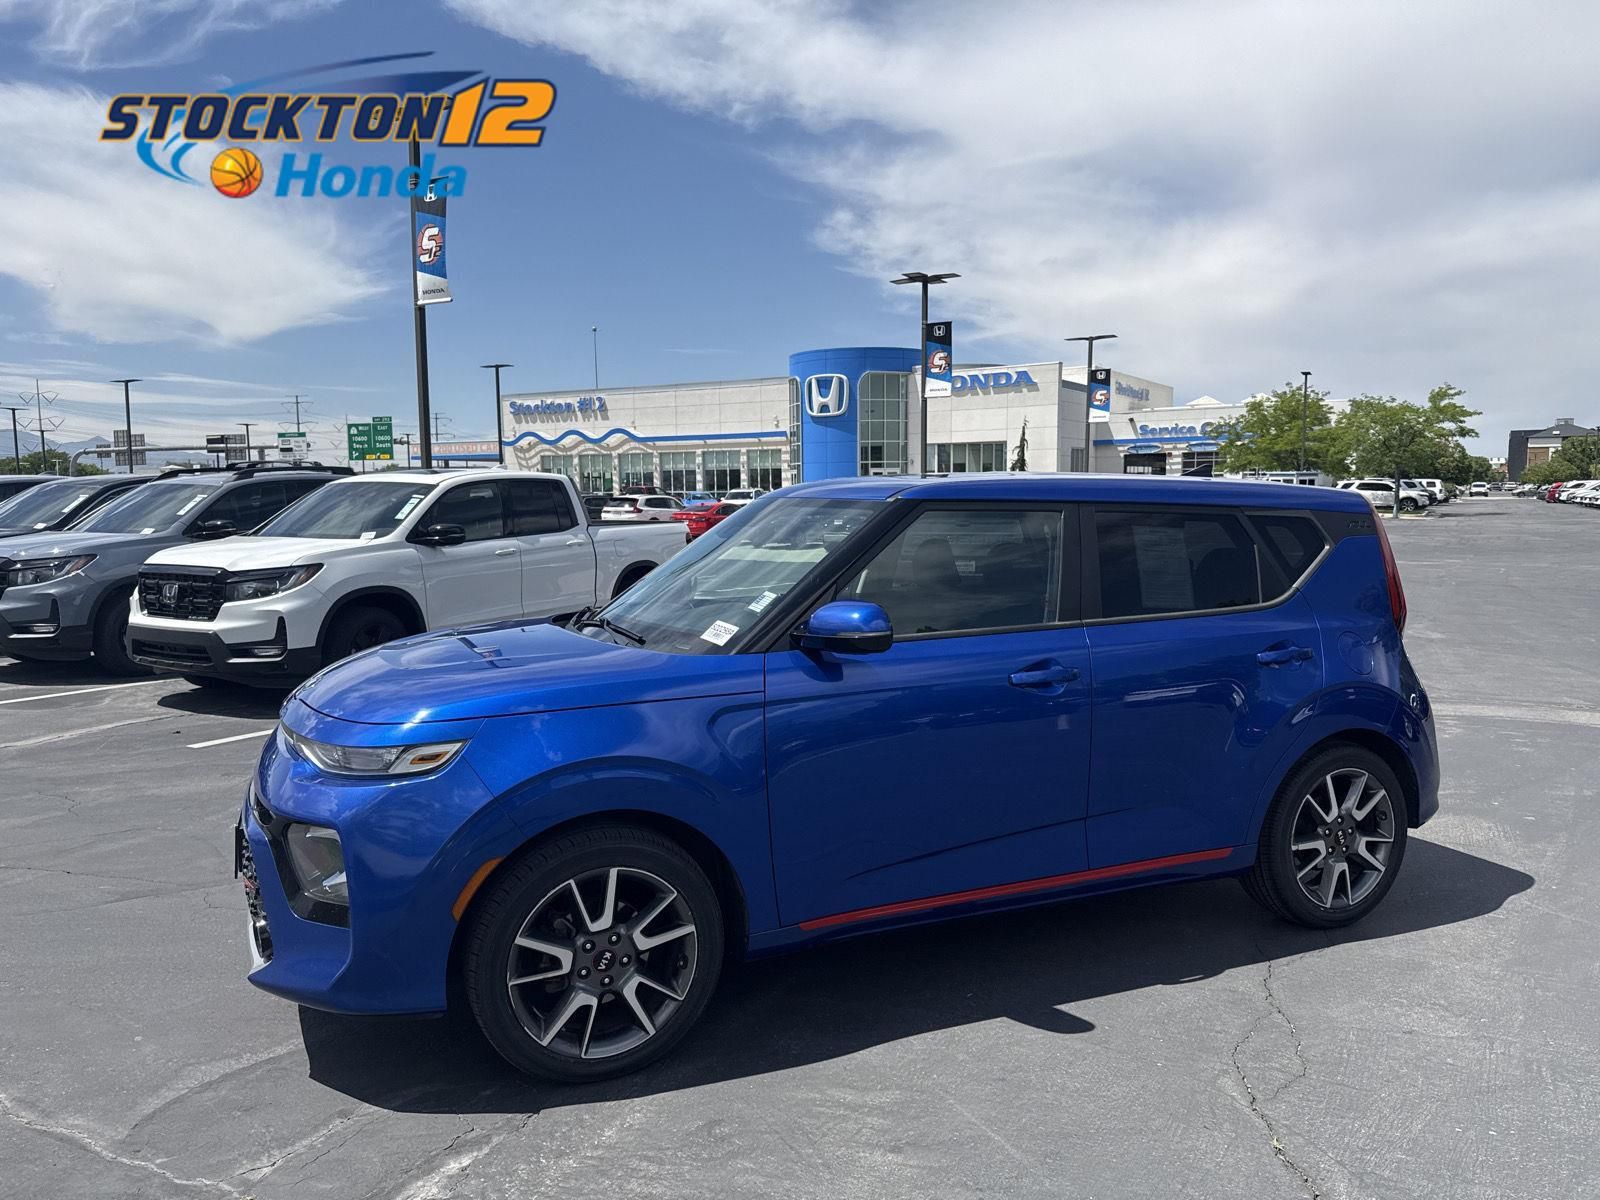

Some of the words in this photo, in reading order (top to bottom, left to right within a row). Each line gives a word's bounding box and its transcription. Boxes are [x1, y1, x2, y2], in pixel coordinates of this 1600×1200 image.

[422, 287, 446, 296] HONDA
[951, 370, 1037, 393] ONDA
[509, 399, 573, 415] Stockton
[1139, 423, 1198, 436] Service
[1337, 830, 1345, 845] KIA
[597, 951, 612, 970] KIA
